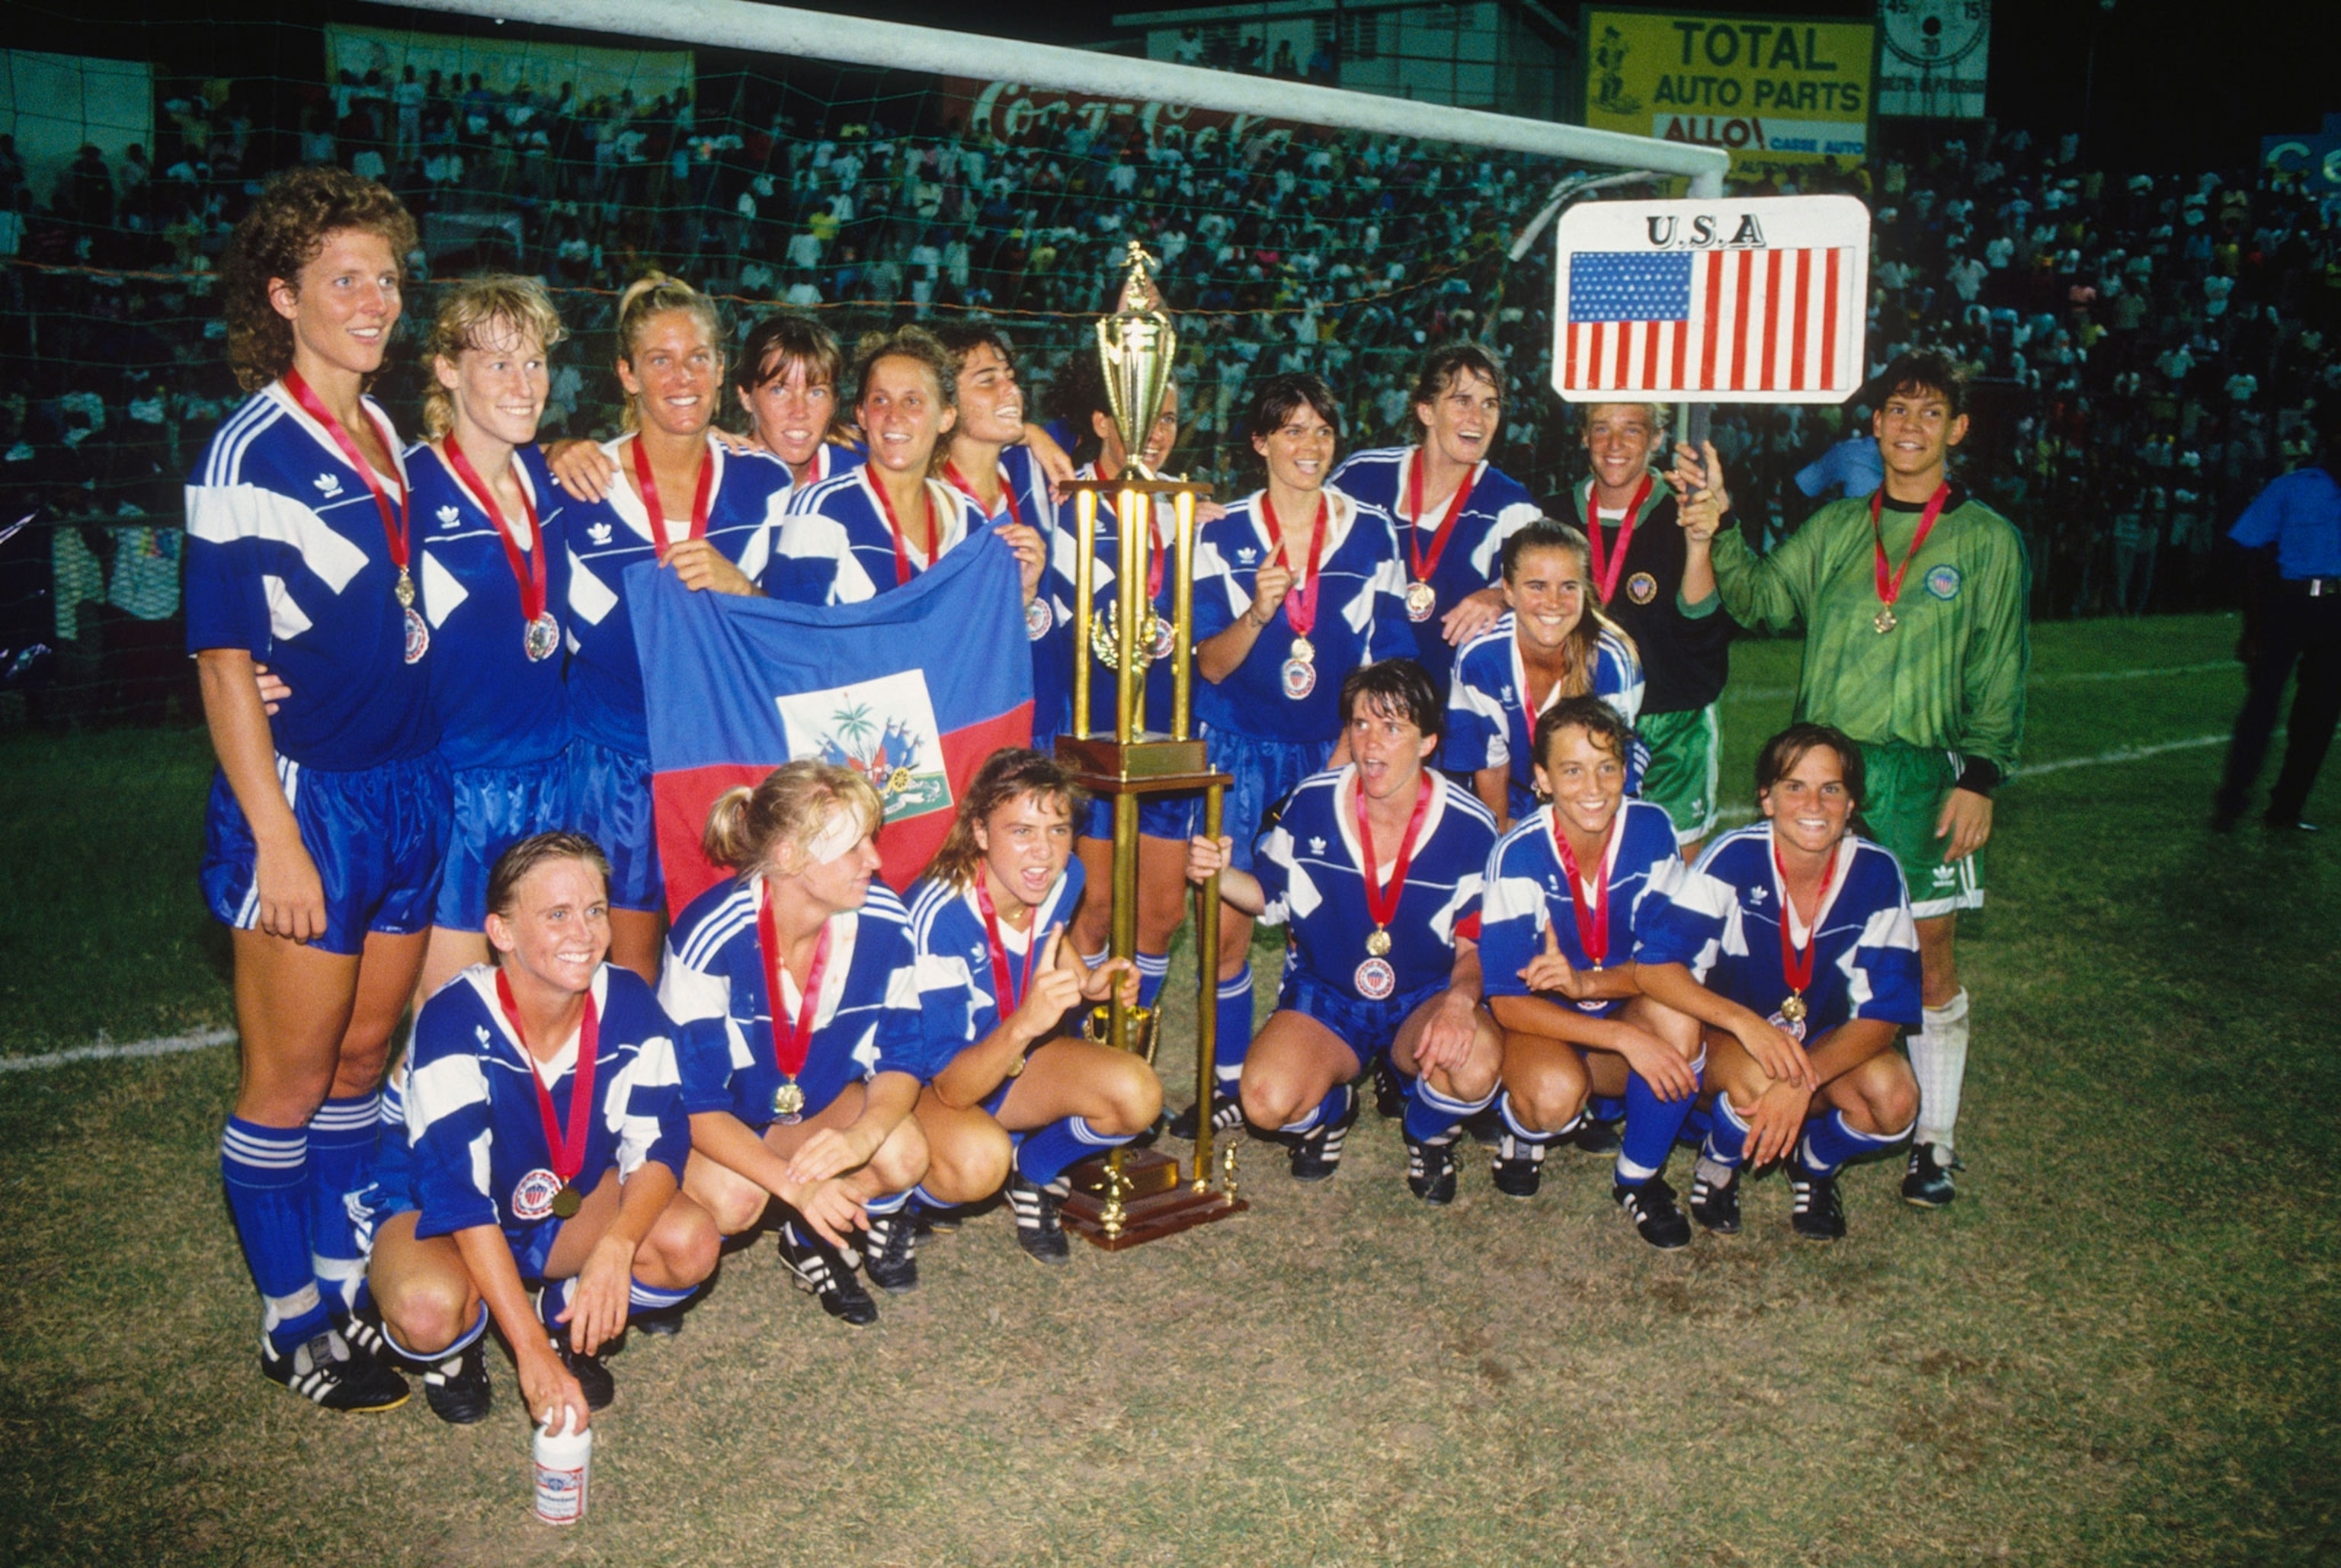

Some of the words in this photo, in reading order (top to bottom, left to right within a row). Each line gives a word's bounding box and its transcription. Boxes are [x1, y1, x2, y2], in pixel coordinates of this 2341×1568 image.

[1964, 2, 1980, 20] 15
[1673, 21, 1837, 72] TOTAL
[1654, 74, 1742, 107] AUTO
[1755, 78, 1862, 112] PARTS
[1824, 140, 1864, 155] AUTO
